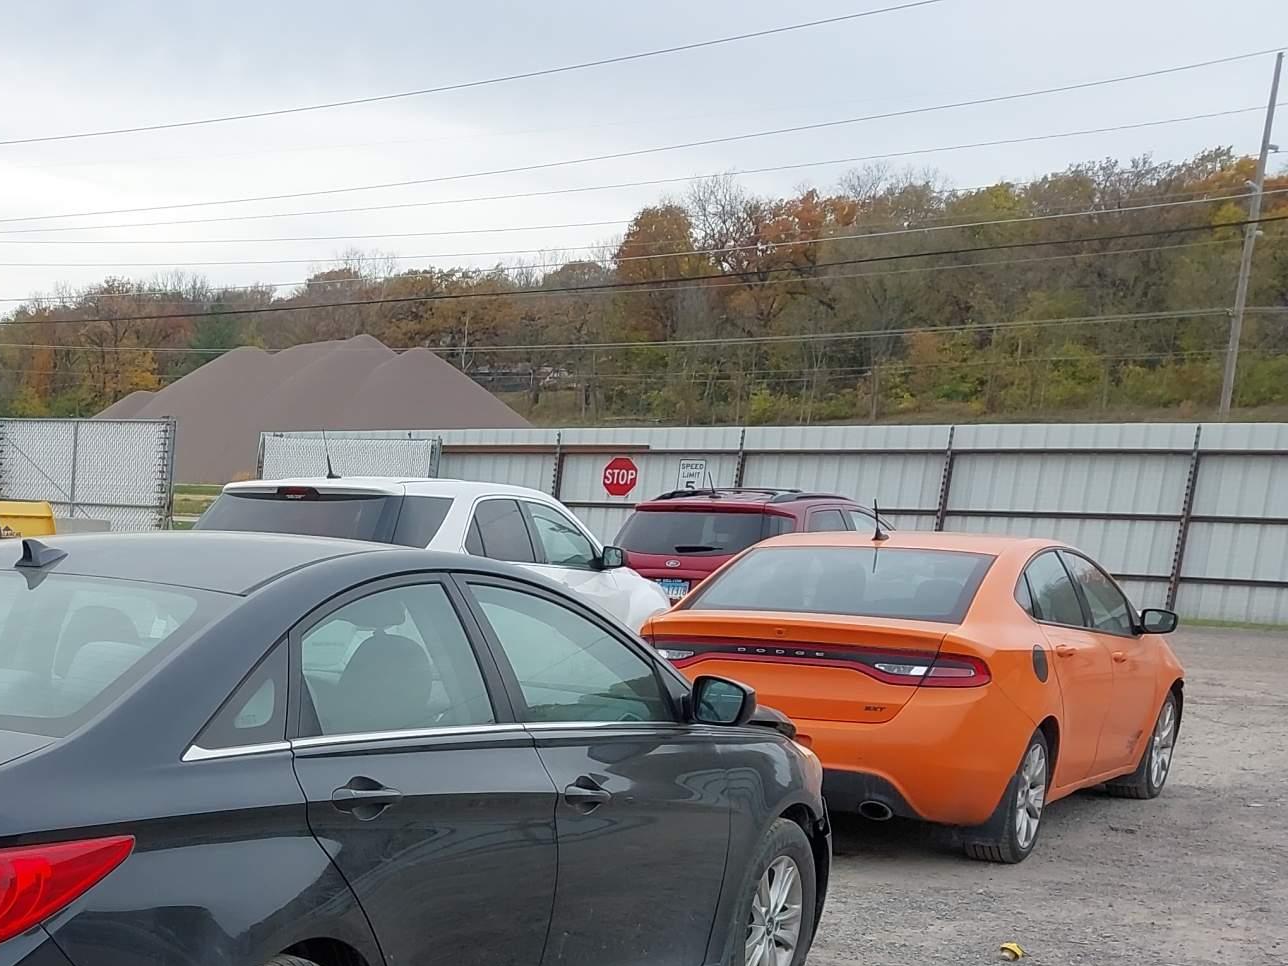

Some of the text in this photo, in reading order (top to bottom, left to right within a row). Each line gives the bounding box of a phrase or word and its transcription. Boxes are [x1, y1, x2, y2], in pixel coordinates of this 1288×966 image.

[604, 469, 636, 485] STOP
[682, 471, 701, 479] LIMIT
[685, 481, 696, 490] 5
[737, 647, 825, 657] DODGE
